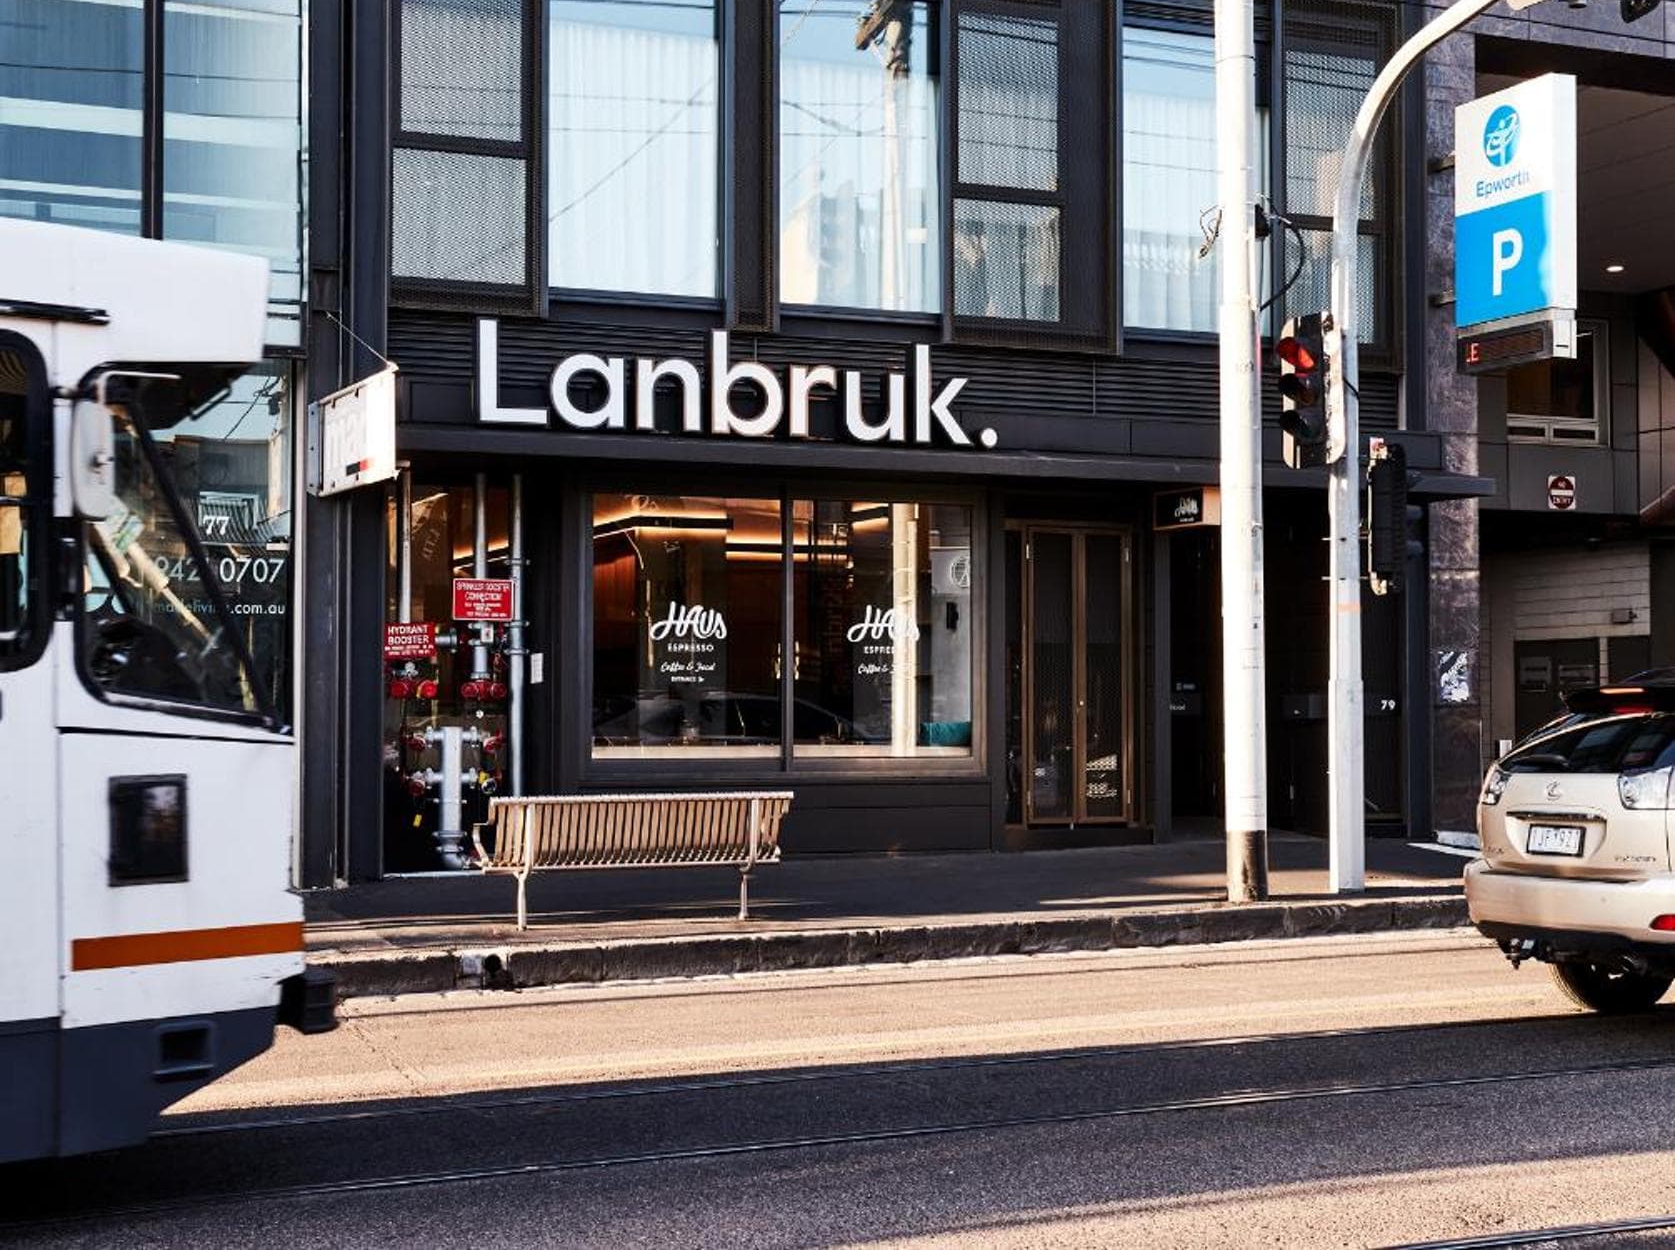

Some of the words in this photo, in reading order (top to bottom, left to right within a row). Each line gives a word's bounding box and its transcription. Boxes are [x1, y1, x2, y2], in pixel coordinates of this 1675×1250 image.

[1476, 168, 1530, 198] Epworth
[1492, 228, 1524, 297] P
[478, 318, 998, 448] Lanbruk.
[203, 515, 230, 535] 77
[154, 556, 210, 582] 942
[219, 557, 285, 583] 0707
[387, 635, 430, 645] BOOSTER
[388, 625, 428, 635] HYDRANT
[667, 643, 714, 652] ESPRESSO
[1381, 699, 1396, 711] 79
